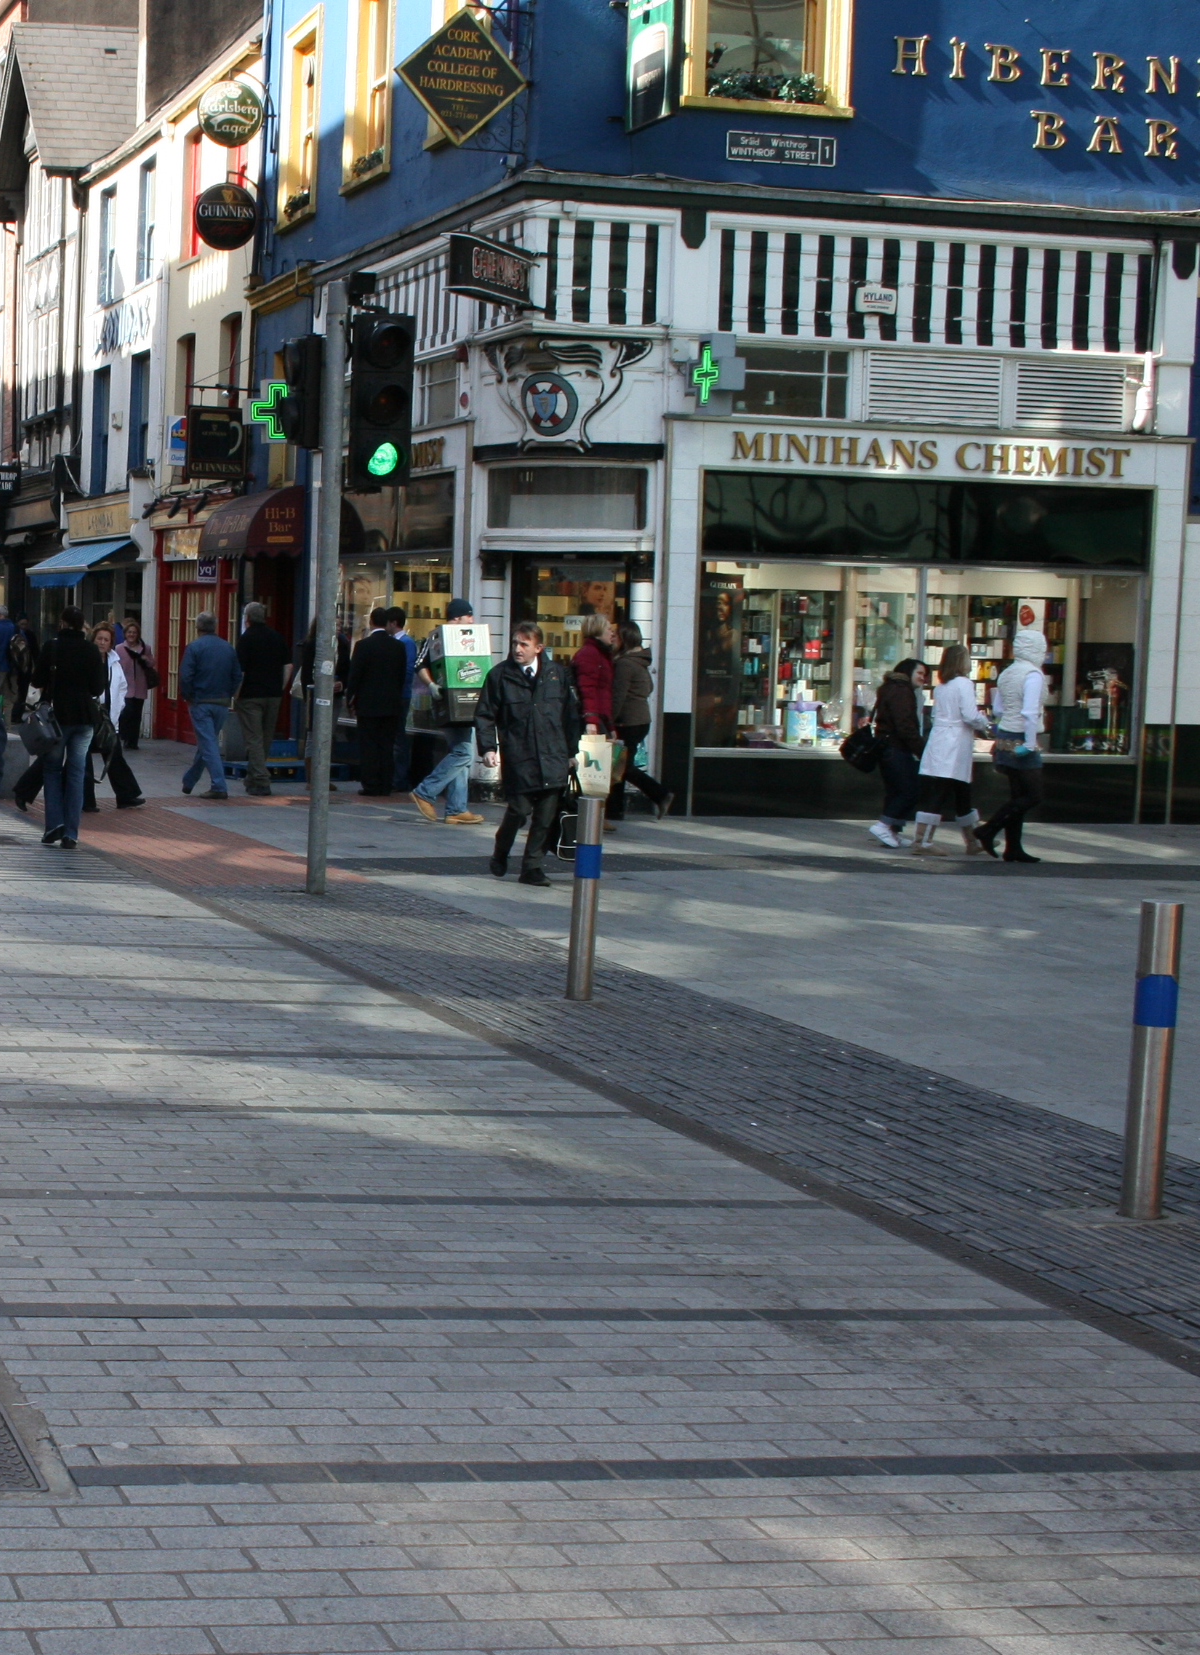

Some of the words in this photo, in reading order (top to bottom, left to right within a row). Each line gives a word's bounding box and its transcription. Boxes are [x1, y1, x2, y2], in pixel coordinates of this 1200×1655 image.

[447, 28, 480, 43] CORK
[433, 45, 492, 61] ACADEMY
[427, 60, 479, 76] COLLEGE
[482, 66, 498, 79] OF
[892, 34, 1200, 97] HIBERN
[419, 76, 504, 96] HAIRDRESSING
[213, 122, 251, 138] Lager
[1030, 109, 1178, 160] BAR
[770, 138, 808, 150] Winthrop
[730, 147, 776, 157] WINTHROP
[784, 150, 817, 160] STREET
[824, 146, 830, 159] 1
[199, 203, 254, 218] GUINNESS
[863, 292, 894, 302] HYLAND
[731, 431, 939, 470] MINIHANS
[955, 442, 1131, 477] CHEMIST
[191, 461, 241, 473] GUINNESS
[264, 507, 296, 519] Hi-B
[268, 521, 292, 532] Bar
[710, 581, 738, 589] GUERLAIN
